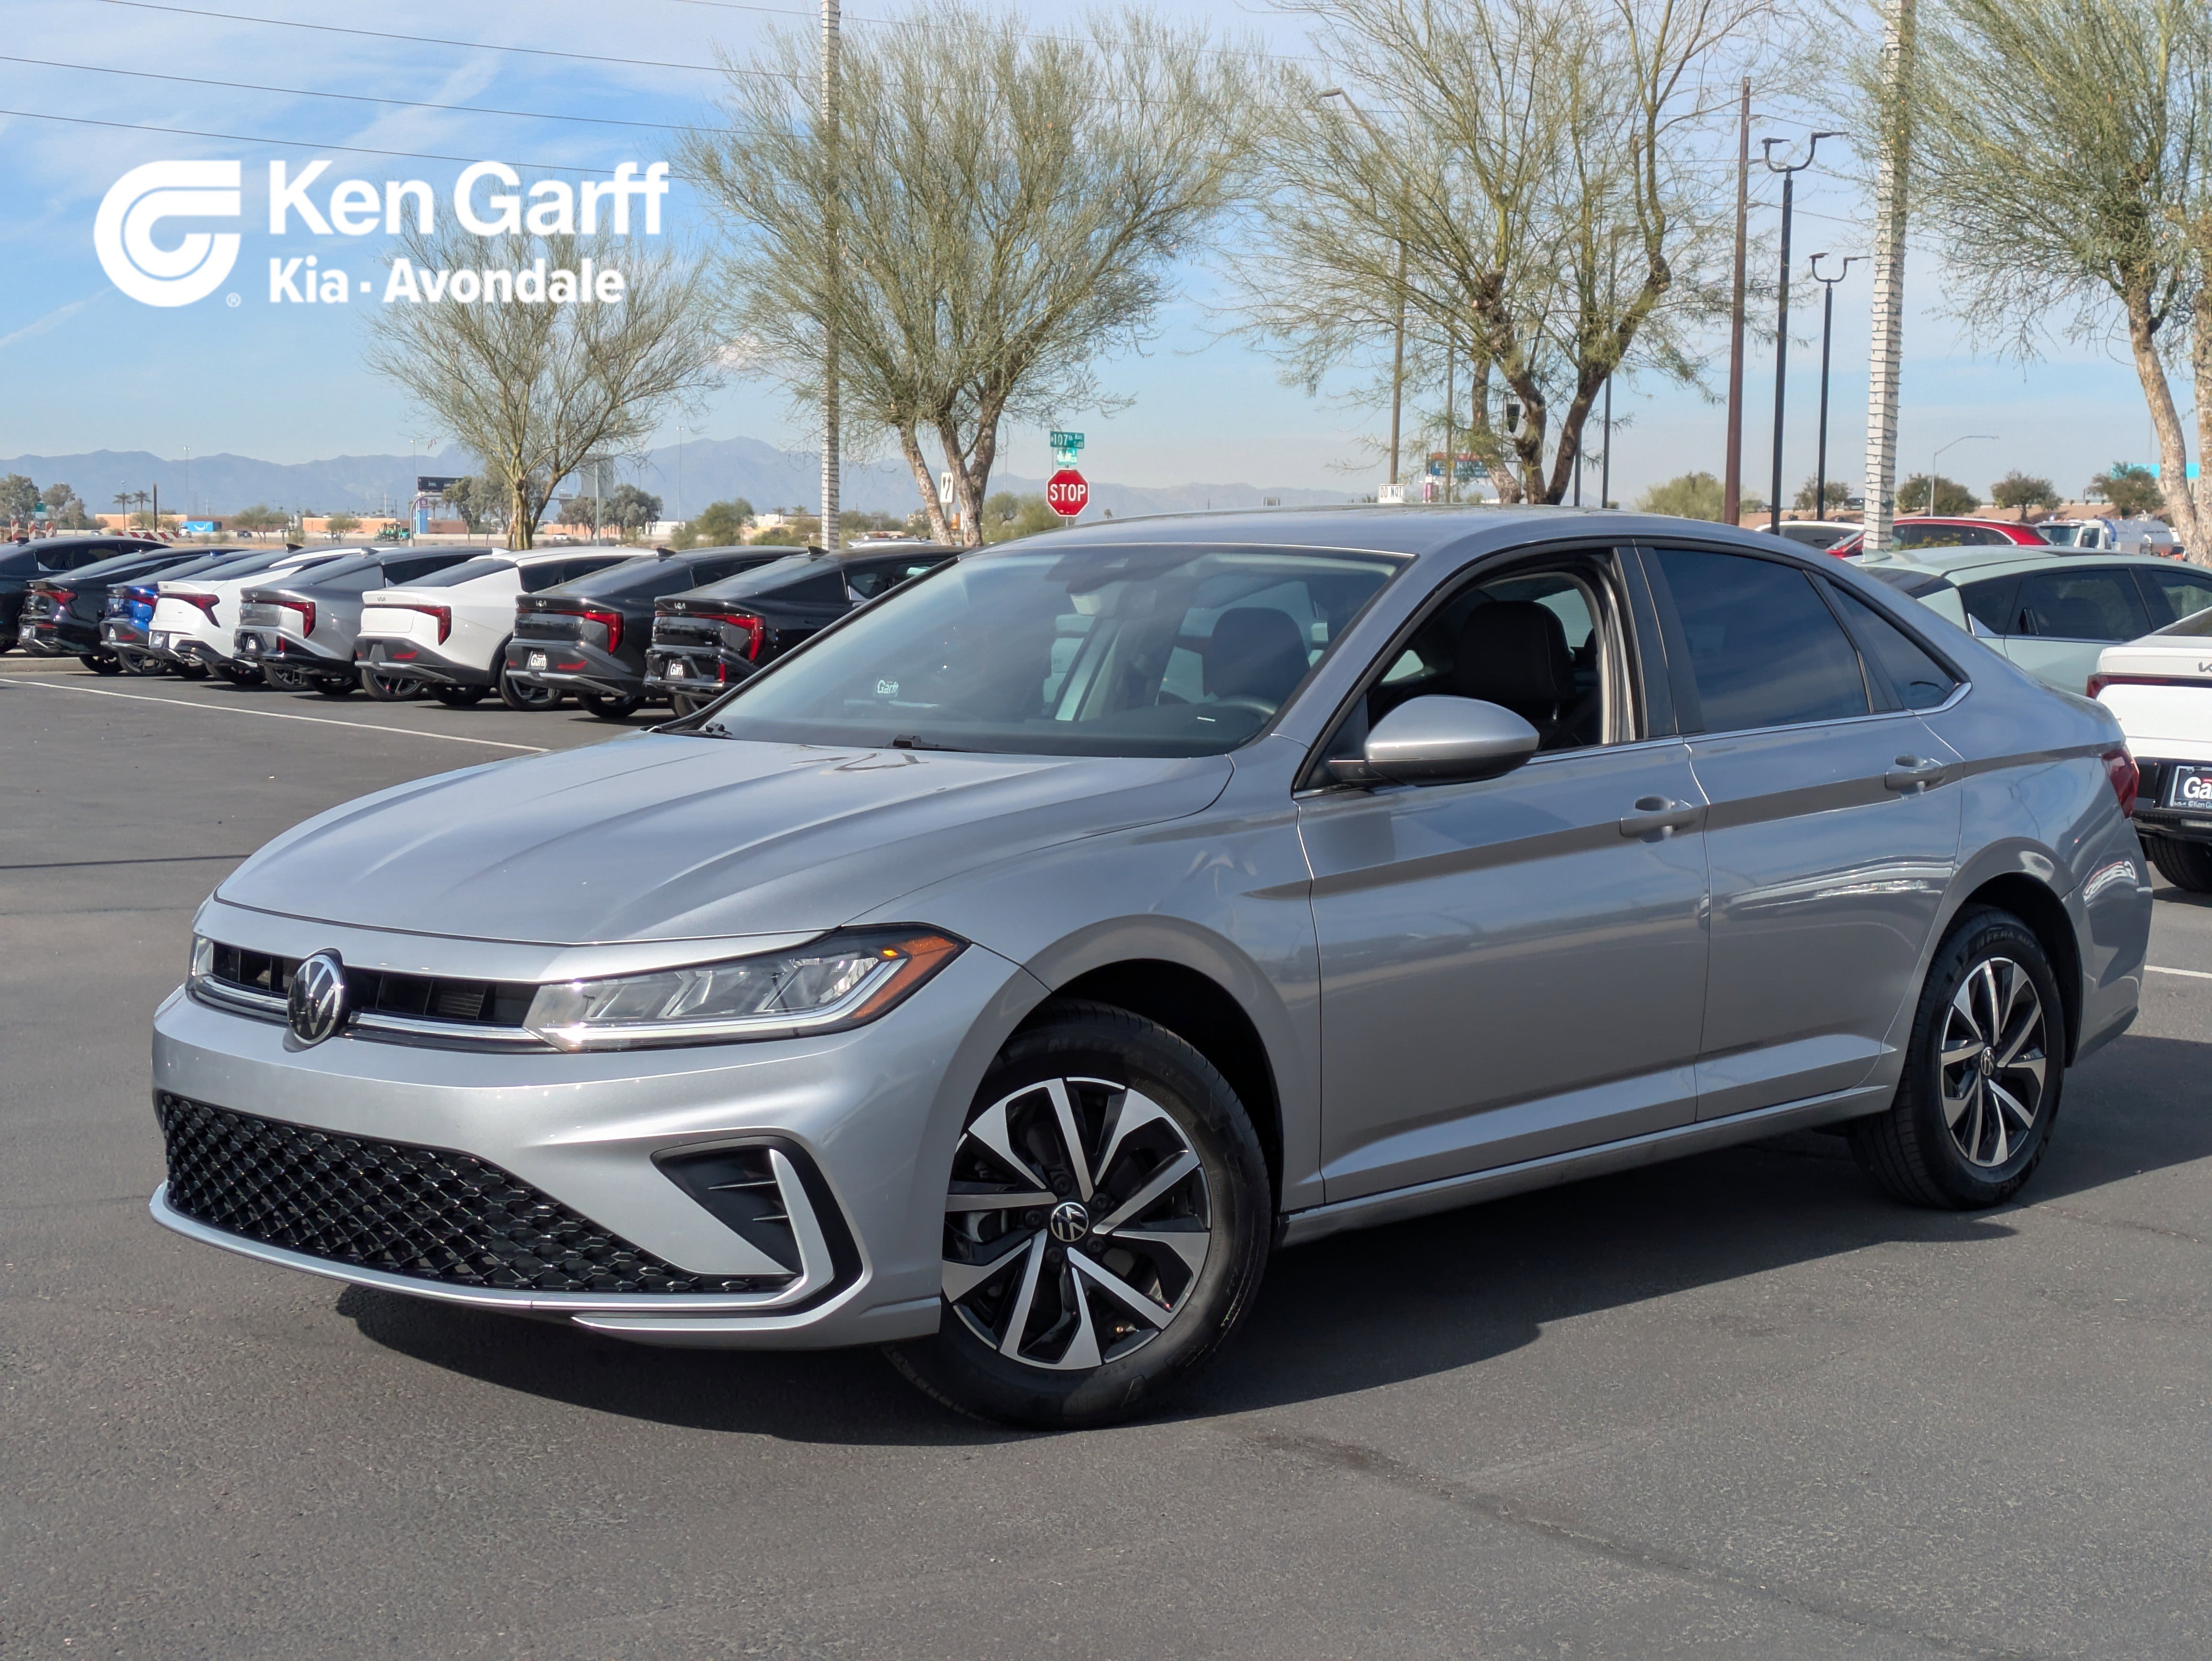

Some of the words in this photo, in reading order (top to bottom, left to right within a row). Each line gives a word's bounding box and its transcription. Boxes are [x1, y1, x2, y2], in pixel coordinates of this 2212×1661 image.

[1050, 483, 1086, 501] STOP
[1380, 486, 1388, 498] DO
[1391, 486, 1402, 498] NOT
